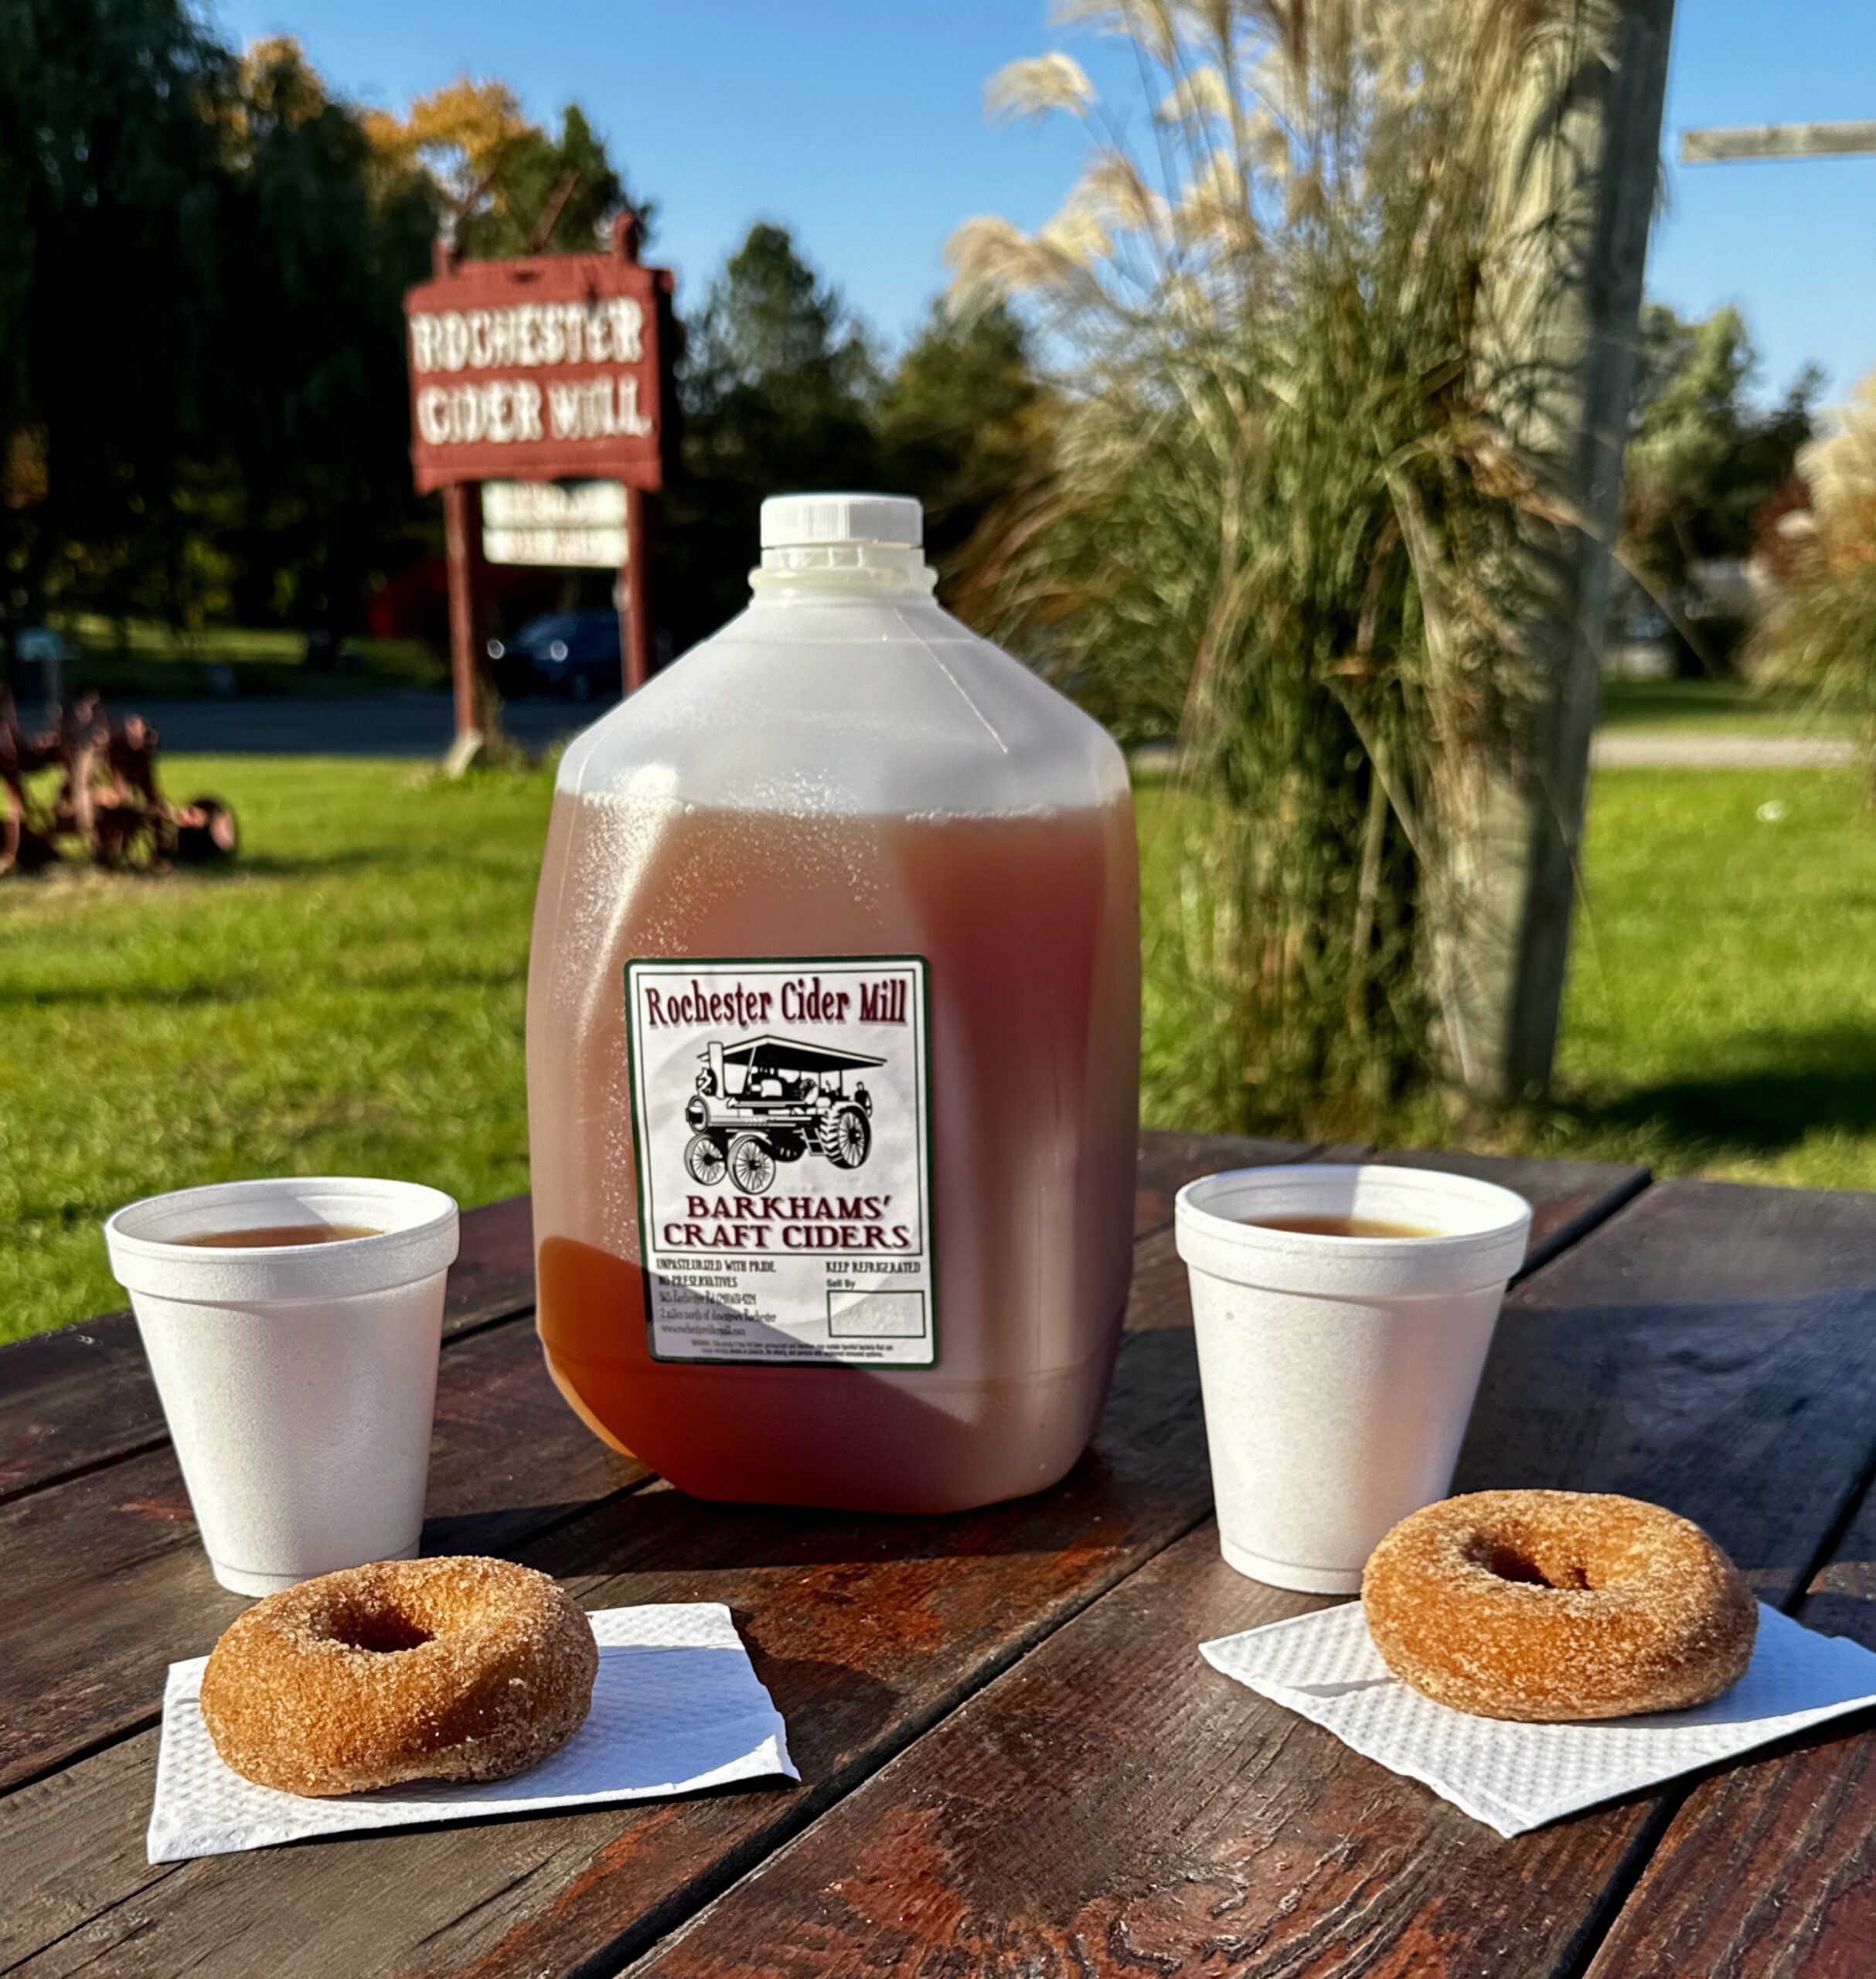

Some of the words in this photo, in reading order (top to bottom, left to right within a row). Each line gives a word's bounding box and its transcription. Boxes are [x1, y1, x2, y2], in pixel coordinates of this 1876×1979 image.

[410, 297, 642, 373] ROCHESTER
[417, 380, 543, 445] CIDER
[548, 375, 652, 441] MILL
[645, 979, 773, 1027] Rochester
[781, 977, 850, 1022] Cider
[860, 979, 907, 1023] Mill
[686, 1195, 891, 1220] BARKHAMS'
[663, 1224, 771, 1248] CRAFT
[782, 1225, 911, 1249] CIDERS
[656, 1259, 722, 1272] UNPASTEURIZED
[725, 1260, 747, 1272] WITH
[826, 1262, 849, 1273] KEEP
[853, 1262, 921, 1273] REFRIGERATED
[659, 1276, 669, 1286] NO
[672, 1276, 737, 1287] PRESERVATIVES
[826, 1279, 843, 1288] Sell
[845, 1279, 856, 1289] By
